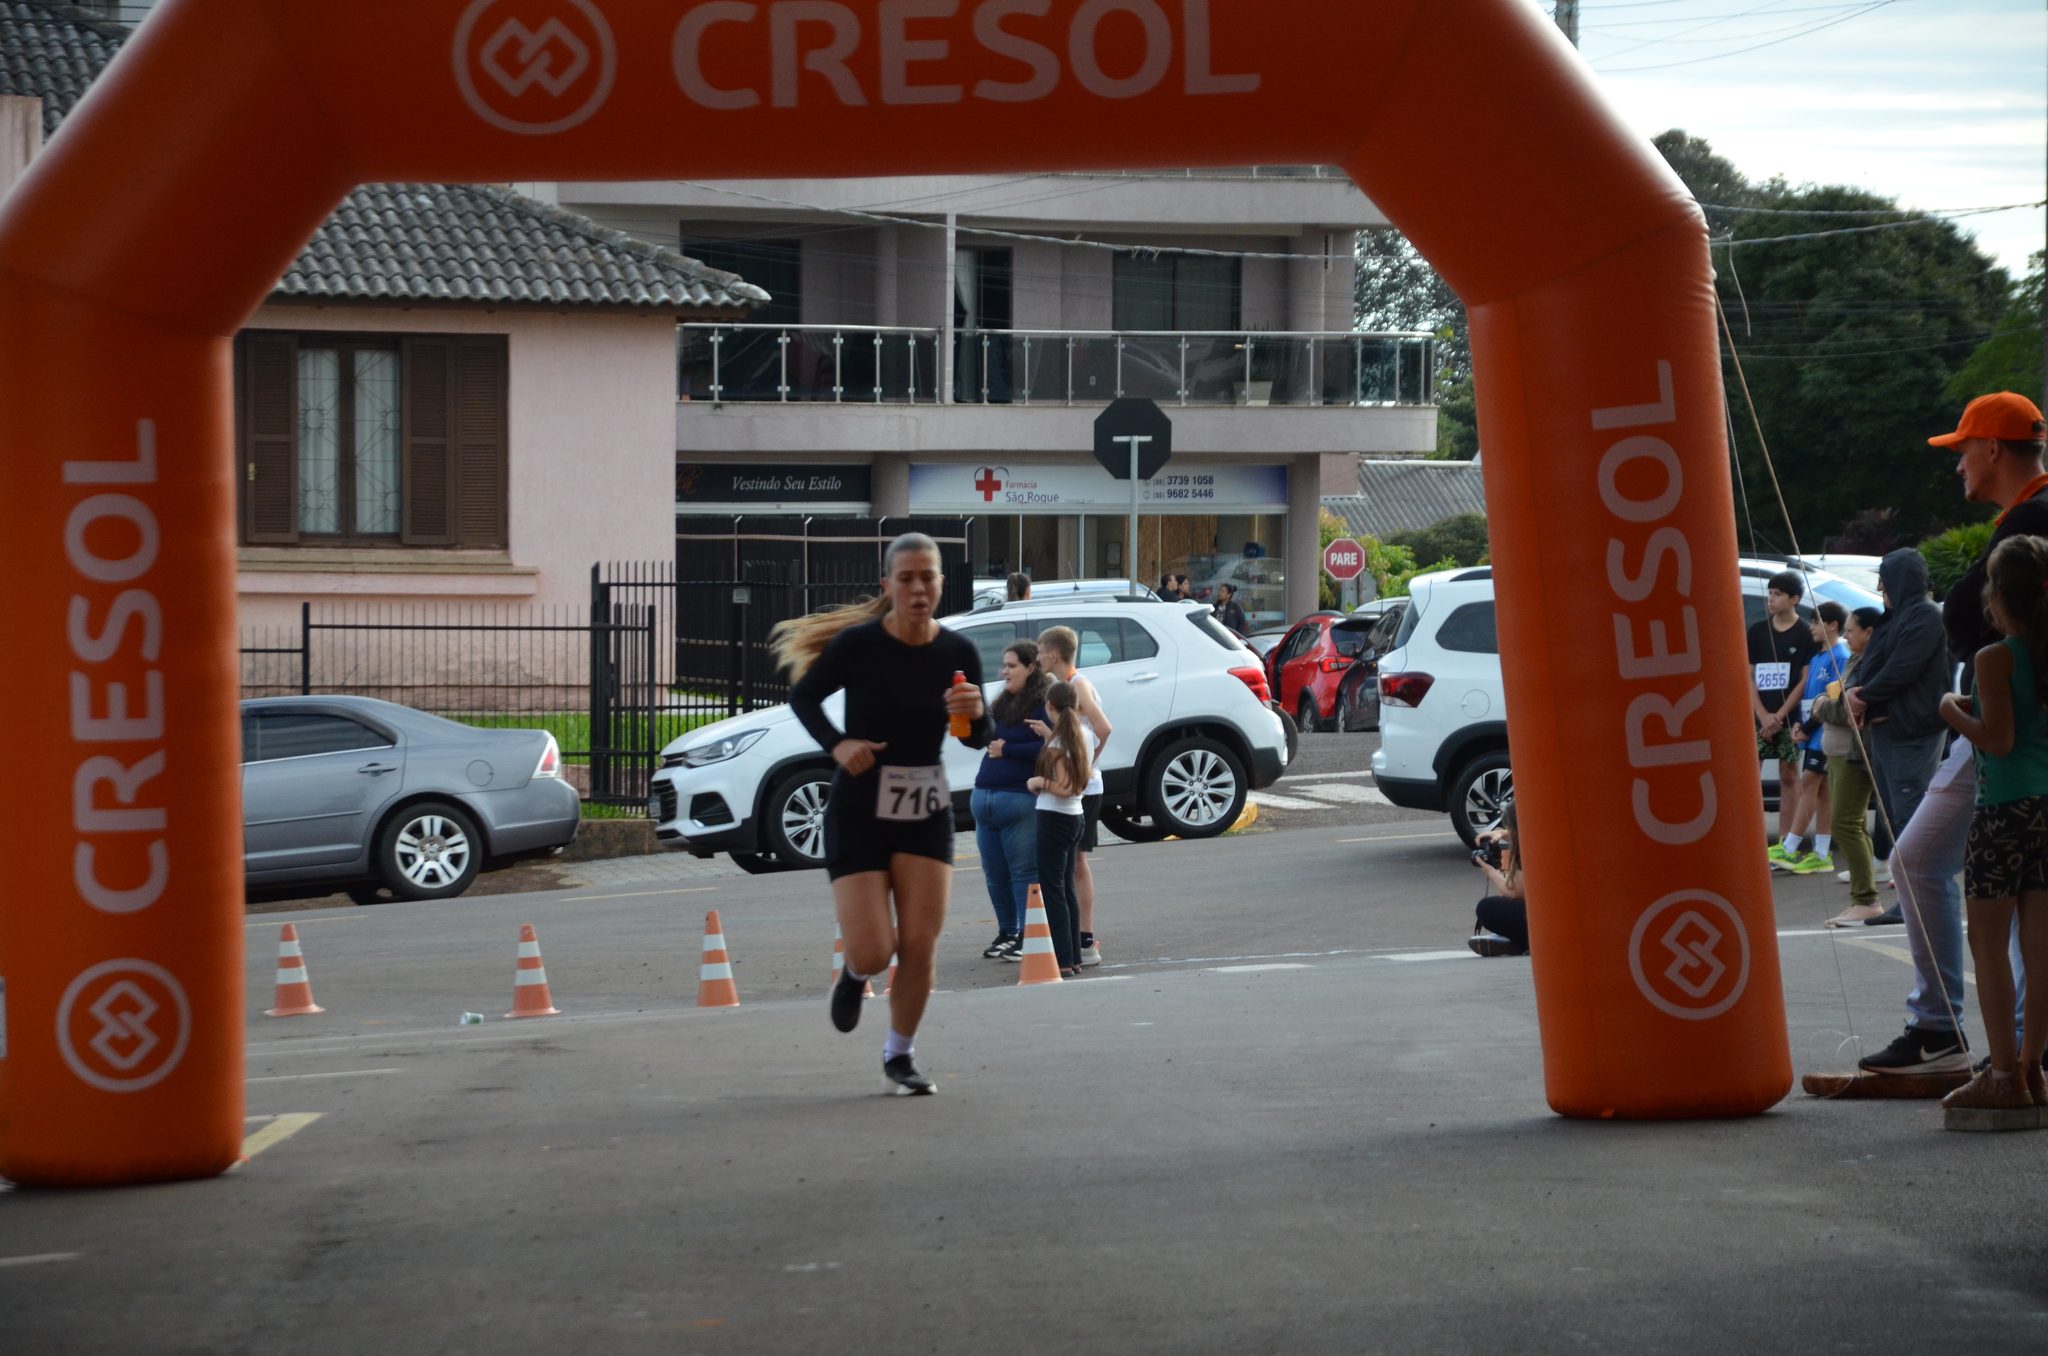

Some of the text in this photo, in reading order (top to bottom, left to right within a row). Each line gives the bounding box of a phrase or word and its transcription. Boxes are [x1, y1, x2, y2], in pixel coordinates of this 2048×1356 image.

[672, 0, 1261, 110] CRESOL
[732, 476, 842, 490] Vestindo Seu Estilo
[1005, 480, 1037, 489] Farmácia
[1167, 475, 1189, 485] 3739
[1193, 475, 1214, 485] 1058
[1005, 491, 1024, 503] São
[1028, 491, 1059, 504] Roque
[1167, 489, 1189, 498] 9682
[1192, 489, 1214, 498] 5446
[1331, 552, 1357, 566] PARE
[1591, 359, 1717, 845] CRESOL
[63, 418, 169, 913] CRESOL
[1758, 673, 1786, 688] 2655
[890, 786, 941, 815] 716
